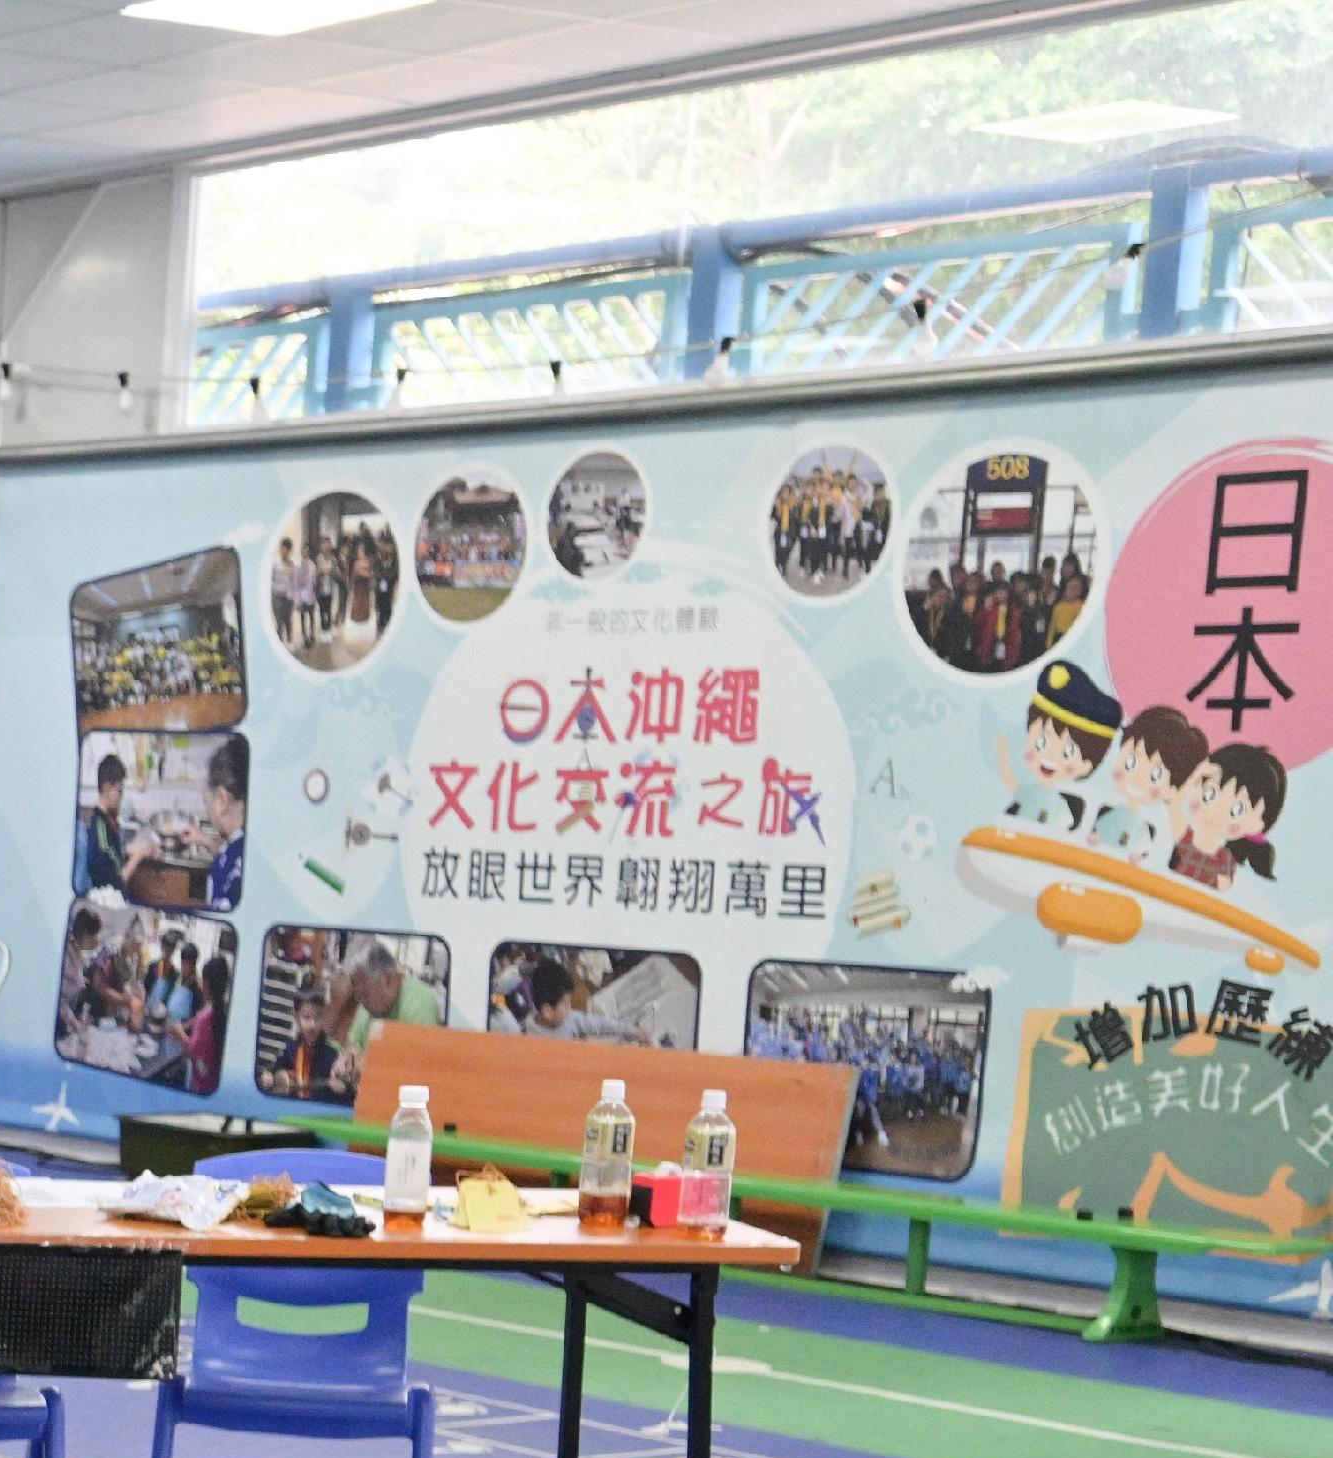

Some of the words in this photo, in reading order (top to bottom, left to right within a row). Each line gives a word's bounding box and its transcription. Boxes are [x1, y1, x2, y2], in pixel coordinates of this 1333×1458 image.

[987, 454, 1030, 480] 508
[1186, 470, 1308, 732] 日本
[499, 663, 761, 746] 日本沖繩
[428, 756, 824, 842] 文化交流之旅
